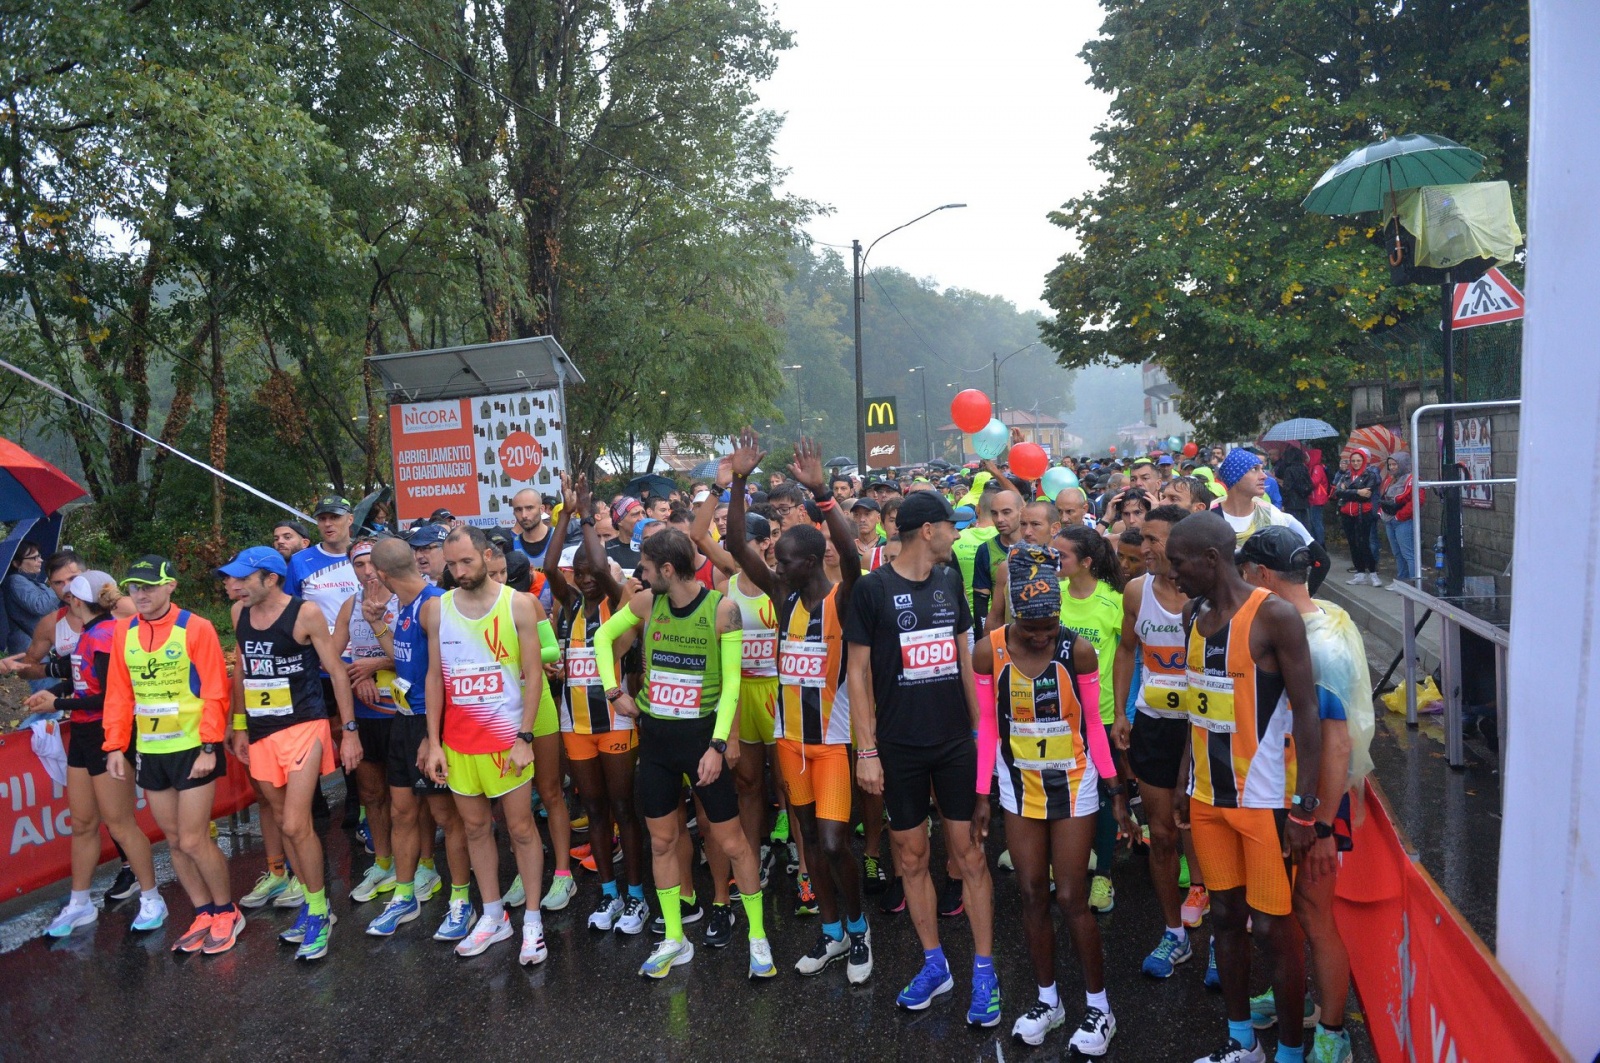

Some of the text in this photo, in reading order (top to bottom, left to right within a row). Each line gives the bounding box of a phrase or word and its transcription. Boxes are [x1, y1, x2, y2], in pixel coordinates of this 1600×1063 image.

[398, 445, 471, 464] ABBIGLIAMENTO
[501, 445, 540, 467] -20%
[399, 462, 472, 481] DA GIARDINAGGIO
[407, 483, 466, 498] VERDEMAX
[474, 517, 499, 526] VARESE
[245, 641, 274, 654] EA7
[662, 634, 708, 645] MERCURIO
[742, 641, 773, 658] 008
[907, 641, 954, 666] 1090
[568, 659, 596, 676] 100
[652, 653, 706, 666] ARREDO JOLLY
[781, 655, 823, 675] 1003
[452, 675, 498, 695] 1043
[260, 691, 271, 706] 2
[651, 684, 698, 706] 1002
[1166, 691, 1180, 709] 9
[1197, 692, 1208, 714] 3
[150, 717, 159, 732] 7
[1036, 738, 1047, 758] 1
